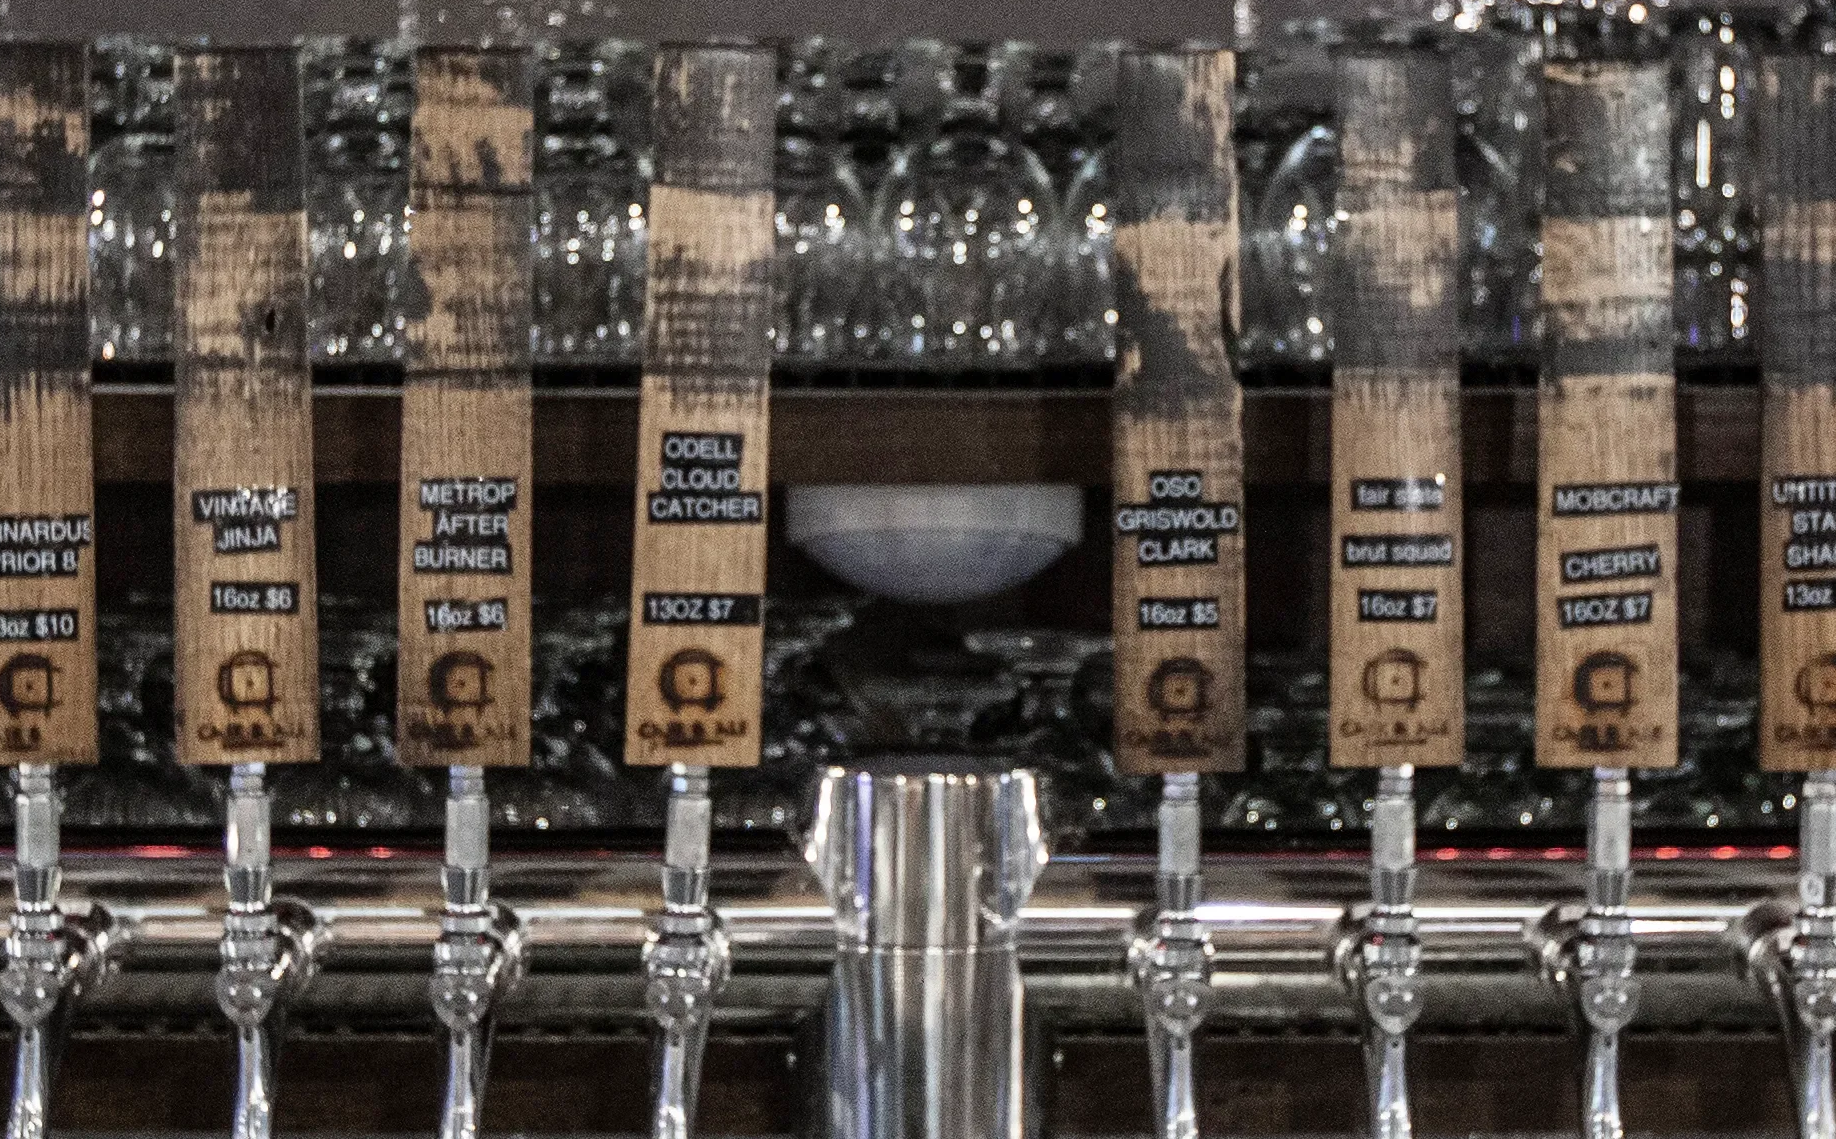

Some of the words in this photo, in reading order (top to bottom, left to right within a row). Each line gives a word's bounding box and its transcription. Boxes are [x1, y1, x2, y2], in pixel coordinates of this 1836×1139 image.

[665, 436, 739, 462] ODELL
[662, 466, 740, 493] CLOUD
[1150, 473, 1202, 501] OSO
[421, 482, 516, 508] METROP
[1358, 482, 1391, 506] fair
[1556, 484, 1680, 513] MOBCRAFT
[651, 497, 760, 523] CATCHER
[1118, 506, 1237, 534] GRISWOLD
[217, 524, 278, 551] JINJA
[436, 513, 508, 537] AFTER
[61, 549, 77, 572] 8
[414, 546, 508, 571] BURNER
[1138, 538, 1215, 565] CLARK
[1347, 539, 1386, 564] brut
[1392, 539, 1452, 566] squad
[1564, 546, 1660, 577] CHERRY
[212, 586, 261, 614] 16oz
[266, 588, 293, 612] $6
[648, 599, 703, 623] 13OZ
[708, 600, 736, 624] $7
[1361, 595, 1407, 620] 16oz
[1411, 593, 1438, 619] $7
[1563, 598, 1619, 625] 16OZ
[1623, 596, 1650, 622] $7
[1787, 585, 1834, 611] 13oz
[35, 613, 74, 637] $10
[426, 603, 473, 629] 16oz
[478, 600, 507, 626] $6
[1141, 601, 1187, 628] 16oz
[1191, 601, 1219, 627] $5
